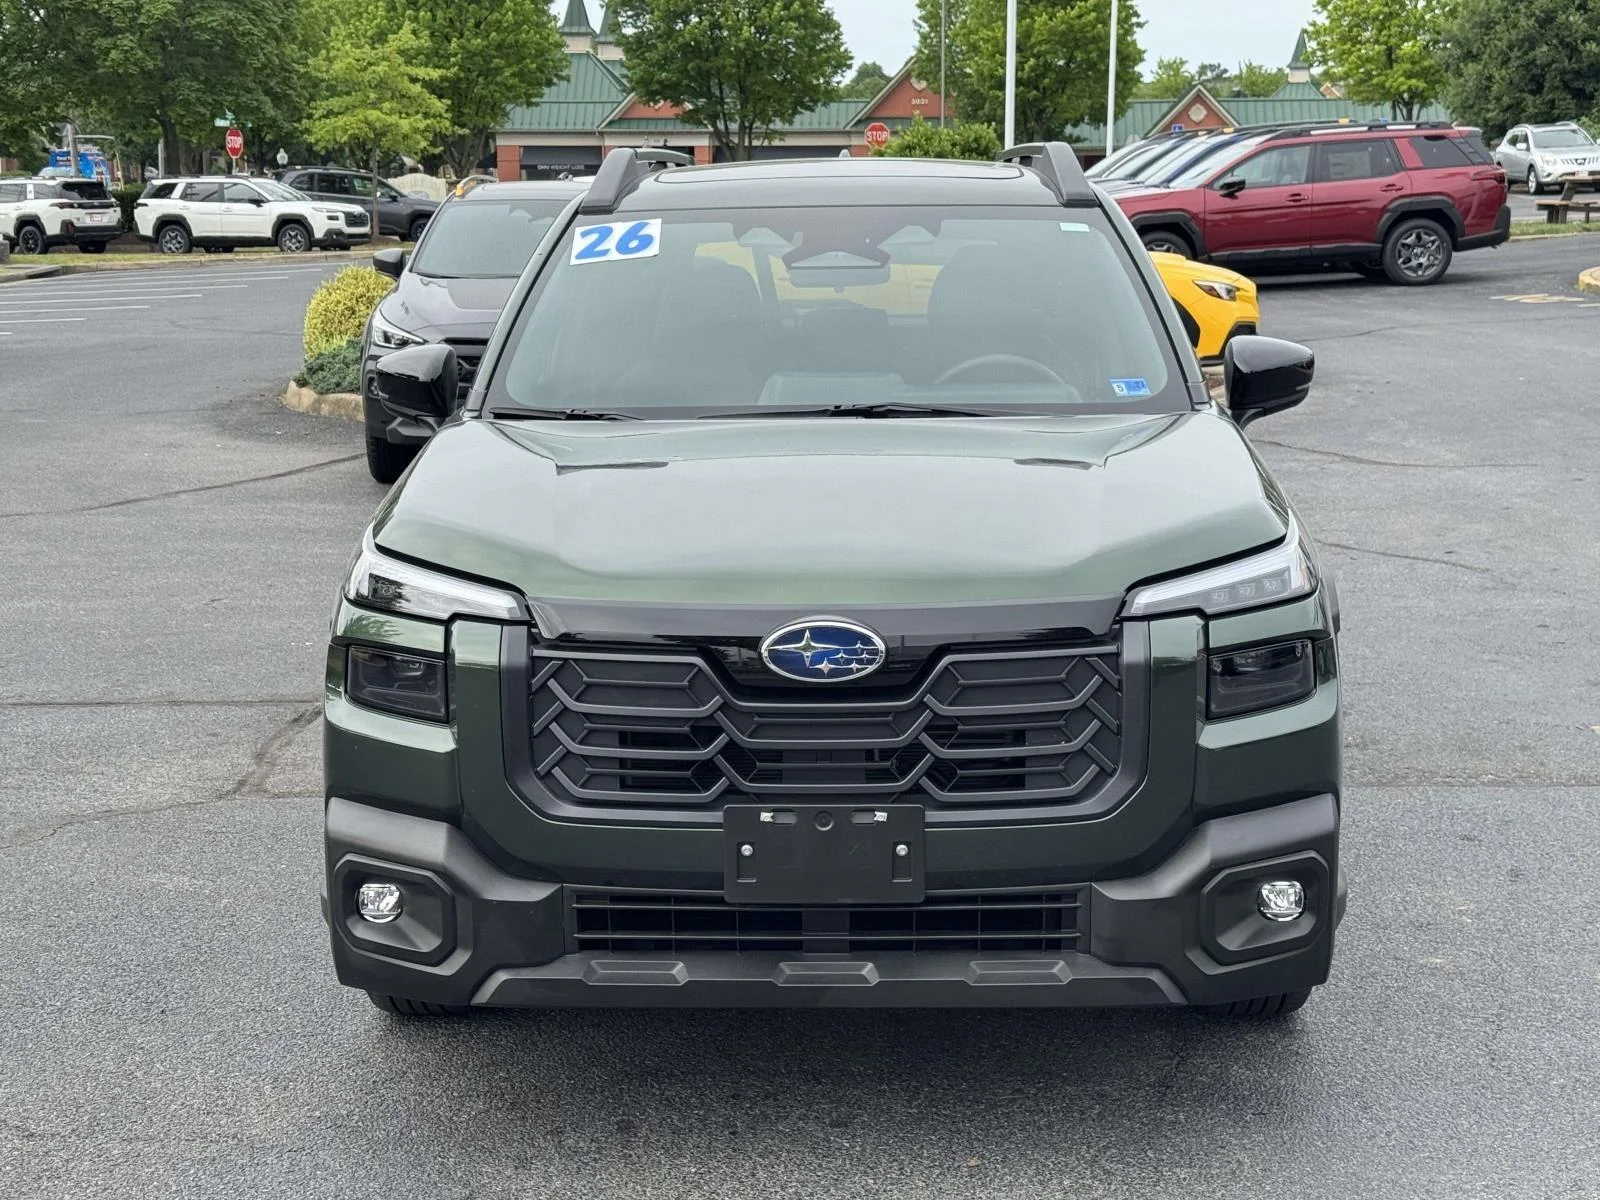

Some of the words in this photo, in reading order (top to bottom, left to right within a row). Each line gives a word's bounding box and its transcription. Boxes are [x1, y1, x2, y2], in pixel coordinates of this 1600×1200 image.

[227, 136, 241, 149] STOP
[866, 131, 888, 142] STOP
[575, 221, 654, 260] 26
